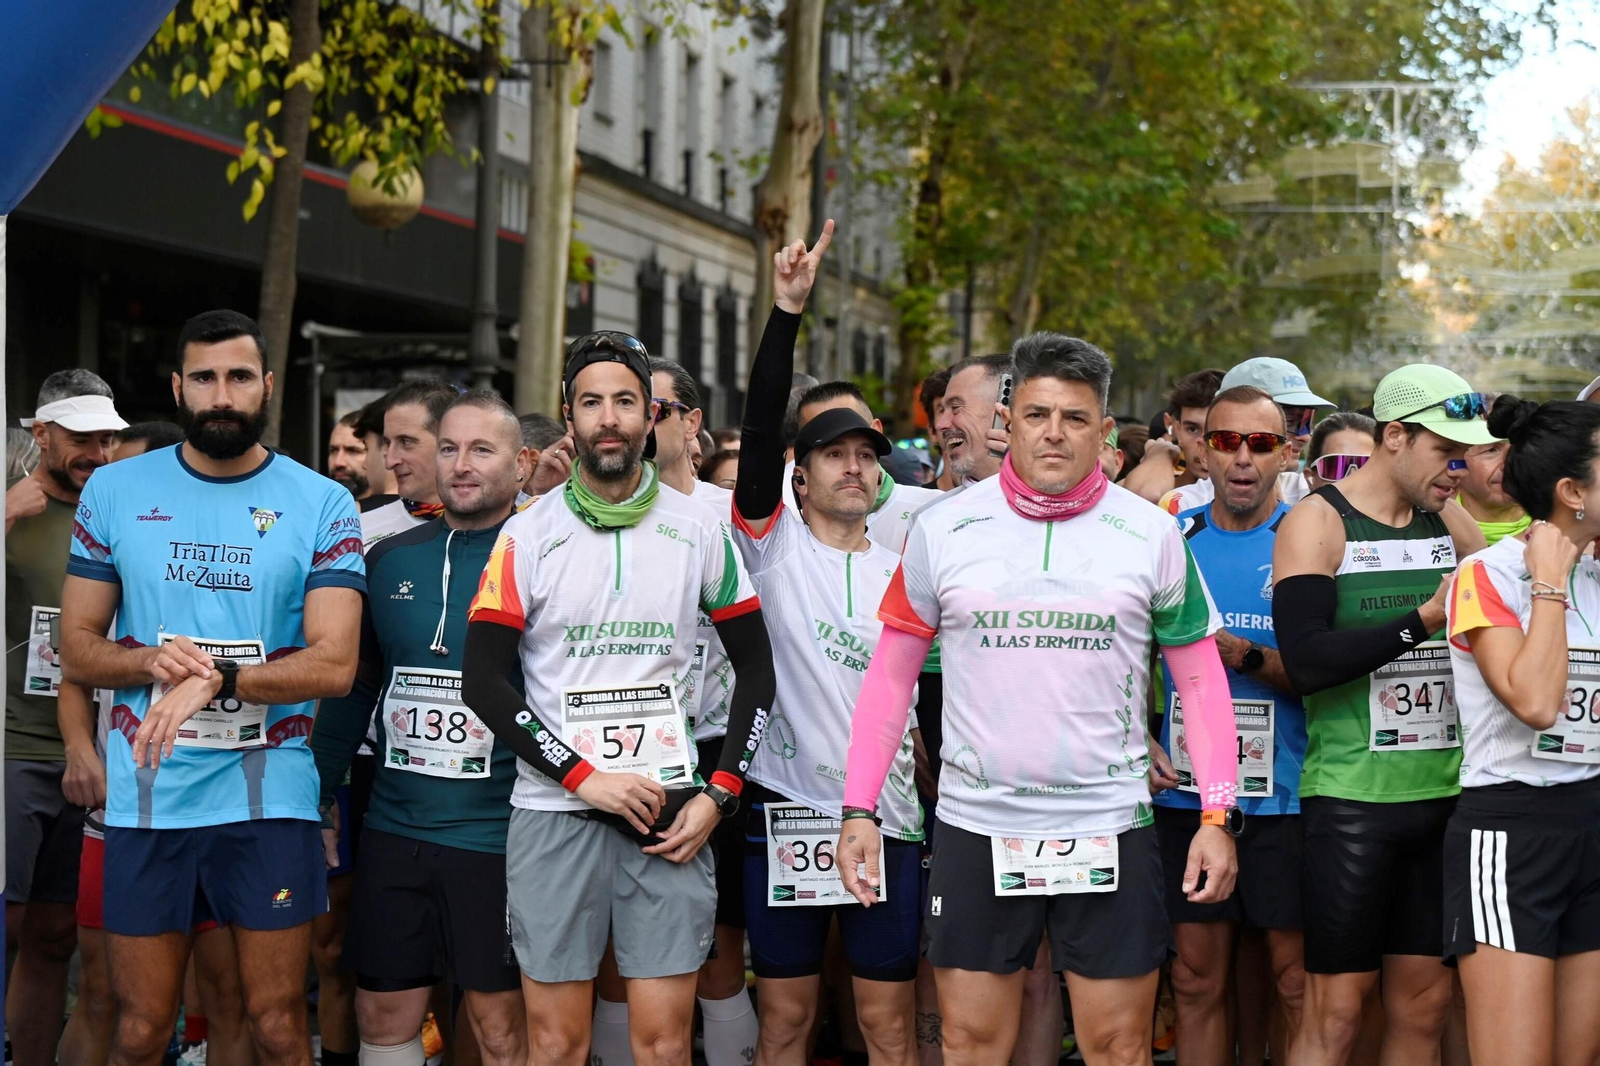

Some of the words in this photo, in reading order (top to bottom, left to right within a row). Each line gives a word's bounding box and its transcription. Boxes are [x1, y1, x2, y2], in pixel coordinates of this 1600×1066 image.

[1099, 513, 1126, 530] SIG
[656, 523, 679, 539] SIG
[1360, 594, 1417, 611] ATLETISMO
[971, 610, 1011, 629] XII
[1017, 610, 1116, 632] SUBIDA
[563, 625, 594, 642] XII
[596, 621, 676, 639] SUBIDA
[980, 635, 991, 648] A
[996, 635, 1031, 648] LAS
[1034, 635, 1113, 650] ERMITAS
[224, 648, 258, 656] ERMITAS
[566, 646, 576, 658] A
[579, 644, 606, 658] LAS
[607, 643, 672, 655] ERMITAS
[1414, 650, 1420, 659] A
[1420, 650, 1433, 659] LAS
[1569, 651, 1594, 661] SUBIDA
[1391, 664, 1400, 672] LA
[407, 675, 431, 684] SUBIDA
[439, 680, 453, 688] LAS
[447, 691, 457, 700] DE
[581, 693, 614, 703] SUBIDA
[622, 690, 637, 699] LAS
[1395, 681, 1446, 715] 347
[569, 705, 584, 716] POR
[585, 705, 594, 715] LA
[634, 703, 642, 712] DE
[406, 706, 467, 744] 138
[603, 724, 645, 759] 57
[785, 809, 813, 818] SUBIDA
[788, 821, 796, 829] LA
[797, 819, 833, 829] DONACIÓN
[834, 821, 842, 829] DE
